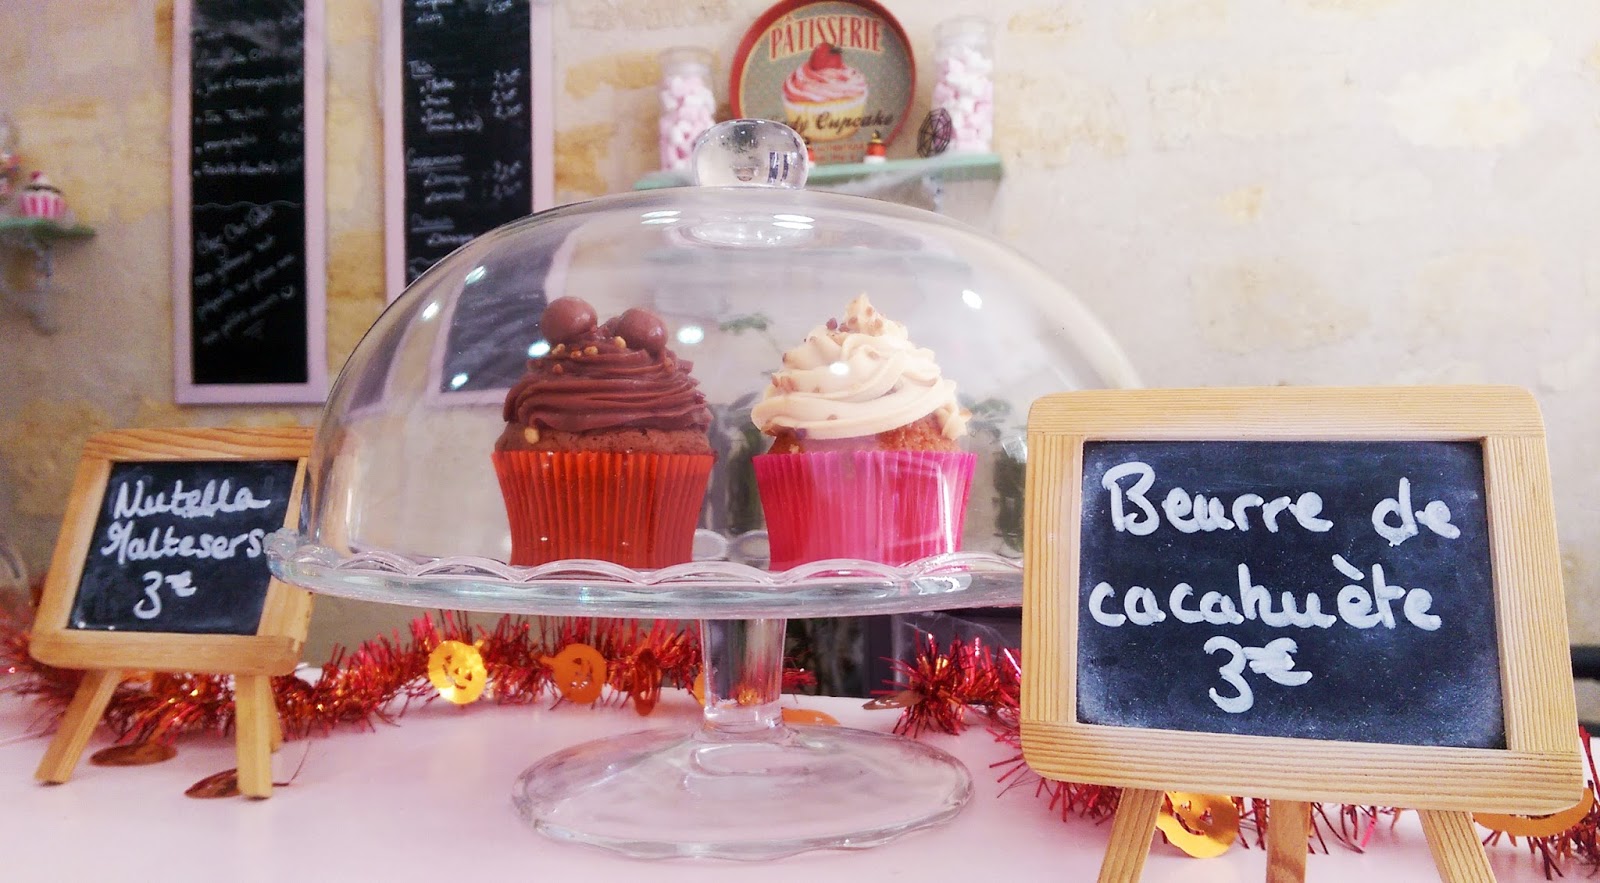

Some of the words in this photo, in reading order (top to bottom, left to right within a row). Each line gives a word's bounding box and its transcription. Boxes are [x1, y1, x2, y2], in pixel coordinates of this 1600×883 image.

[770, 16, 881, 60] PÂTISSERIE
[815, 108, 894, 135] Cupcake
[113, 479, 271, 519] Nutella
[1102, 461, 1334, 537] Beurre
[1371, 477, 1462, 547] de
[101, 520, 265, 565] Maltesers
[1088, 553, 1443, 631] cacahuète
[1203, 635, 1314, 714] 3€
